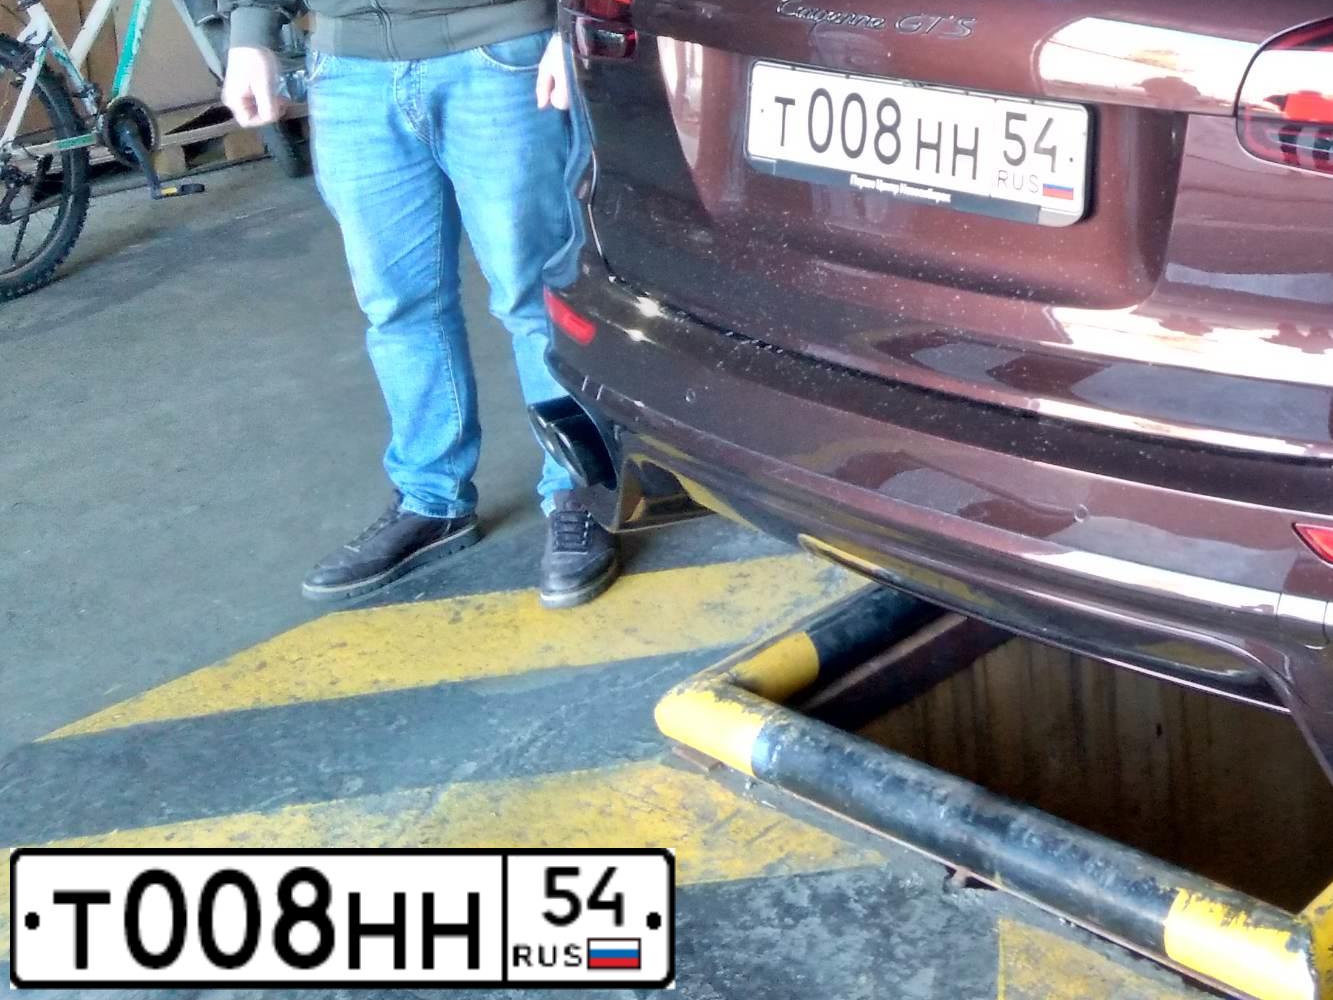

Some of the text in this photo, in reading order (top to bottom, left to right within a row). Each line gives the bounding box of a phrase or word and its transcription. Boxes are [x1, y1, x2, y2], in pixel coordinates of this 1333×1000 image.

[895, 12, 977, 39] GTS
[1002, 111, 1058, 174] 54
[997, 169, 1039, 193] RUS
